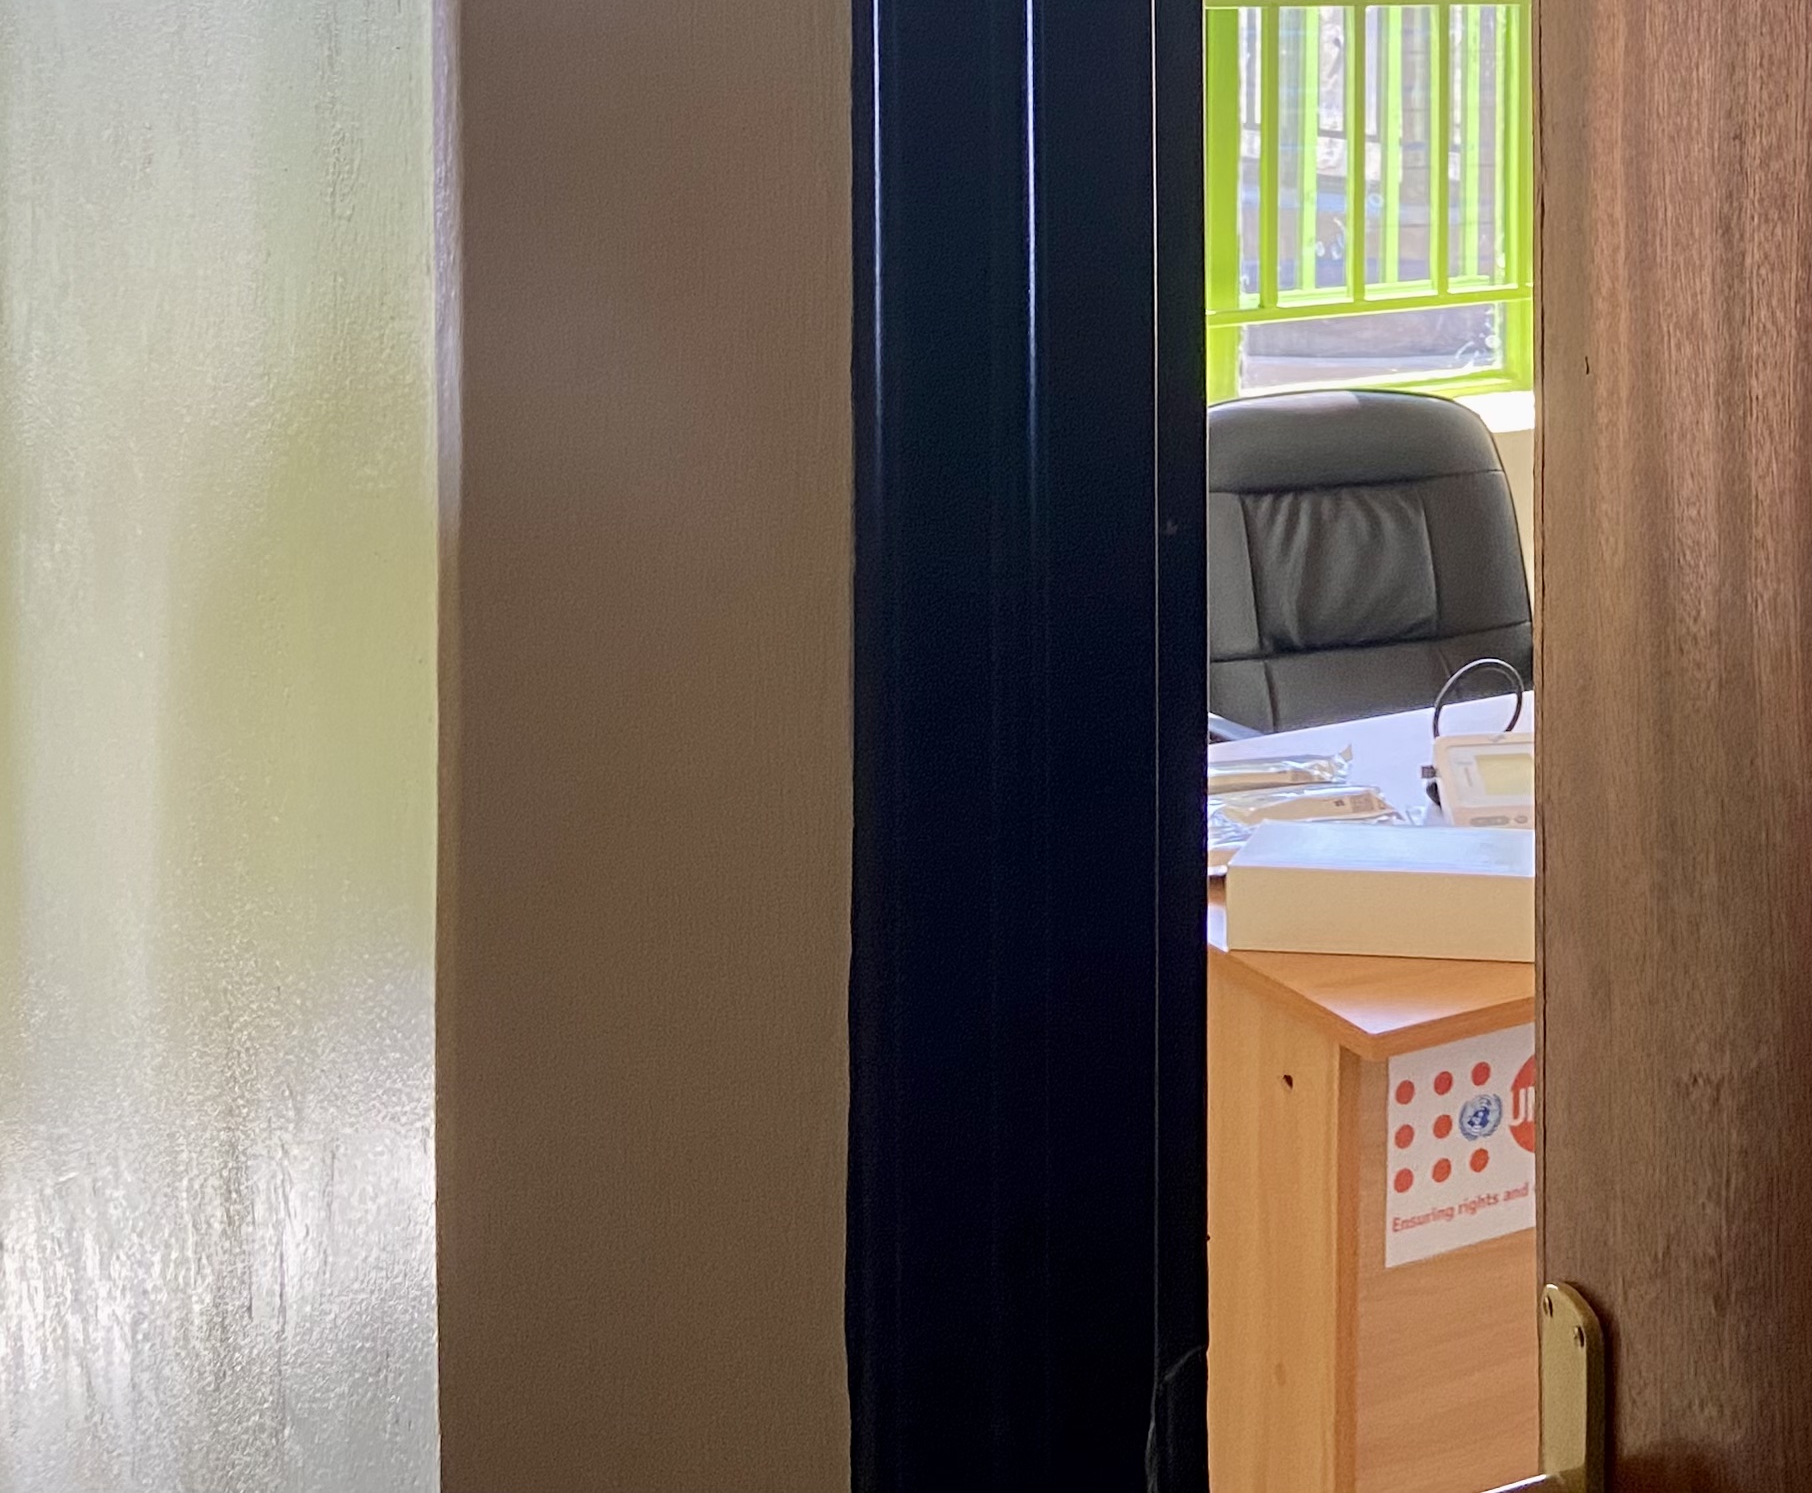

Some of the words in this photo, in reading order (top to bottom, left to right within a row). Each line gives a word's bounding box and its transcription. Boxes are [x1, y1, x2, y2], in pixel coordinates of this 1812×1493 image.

[1392, 1207, 1454, 1232] Ensuring
[1457, 1193, 1499, 1215] rights
[1502, 1182, 1530, 1201] and
